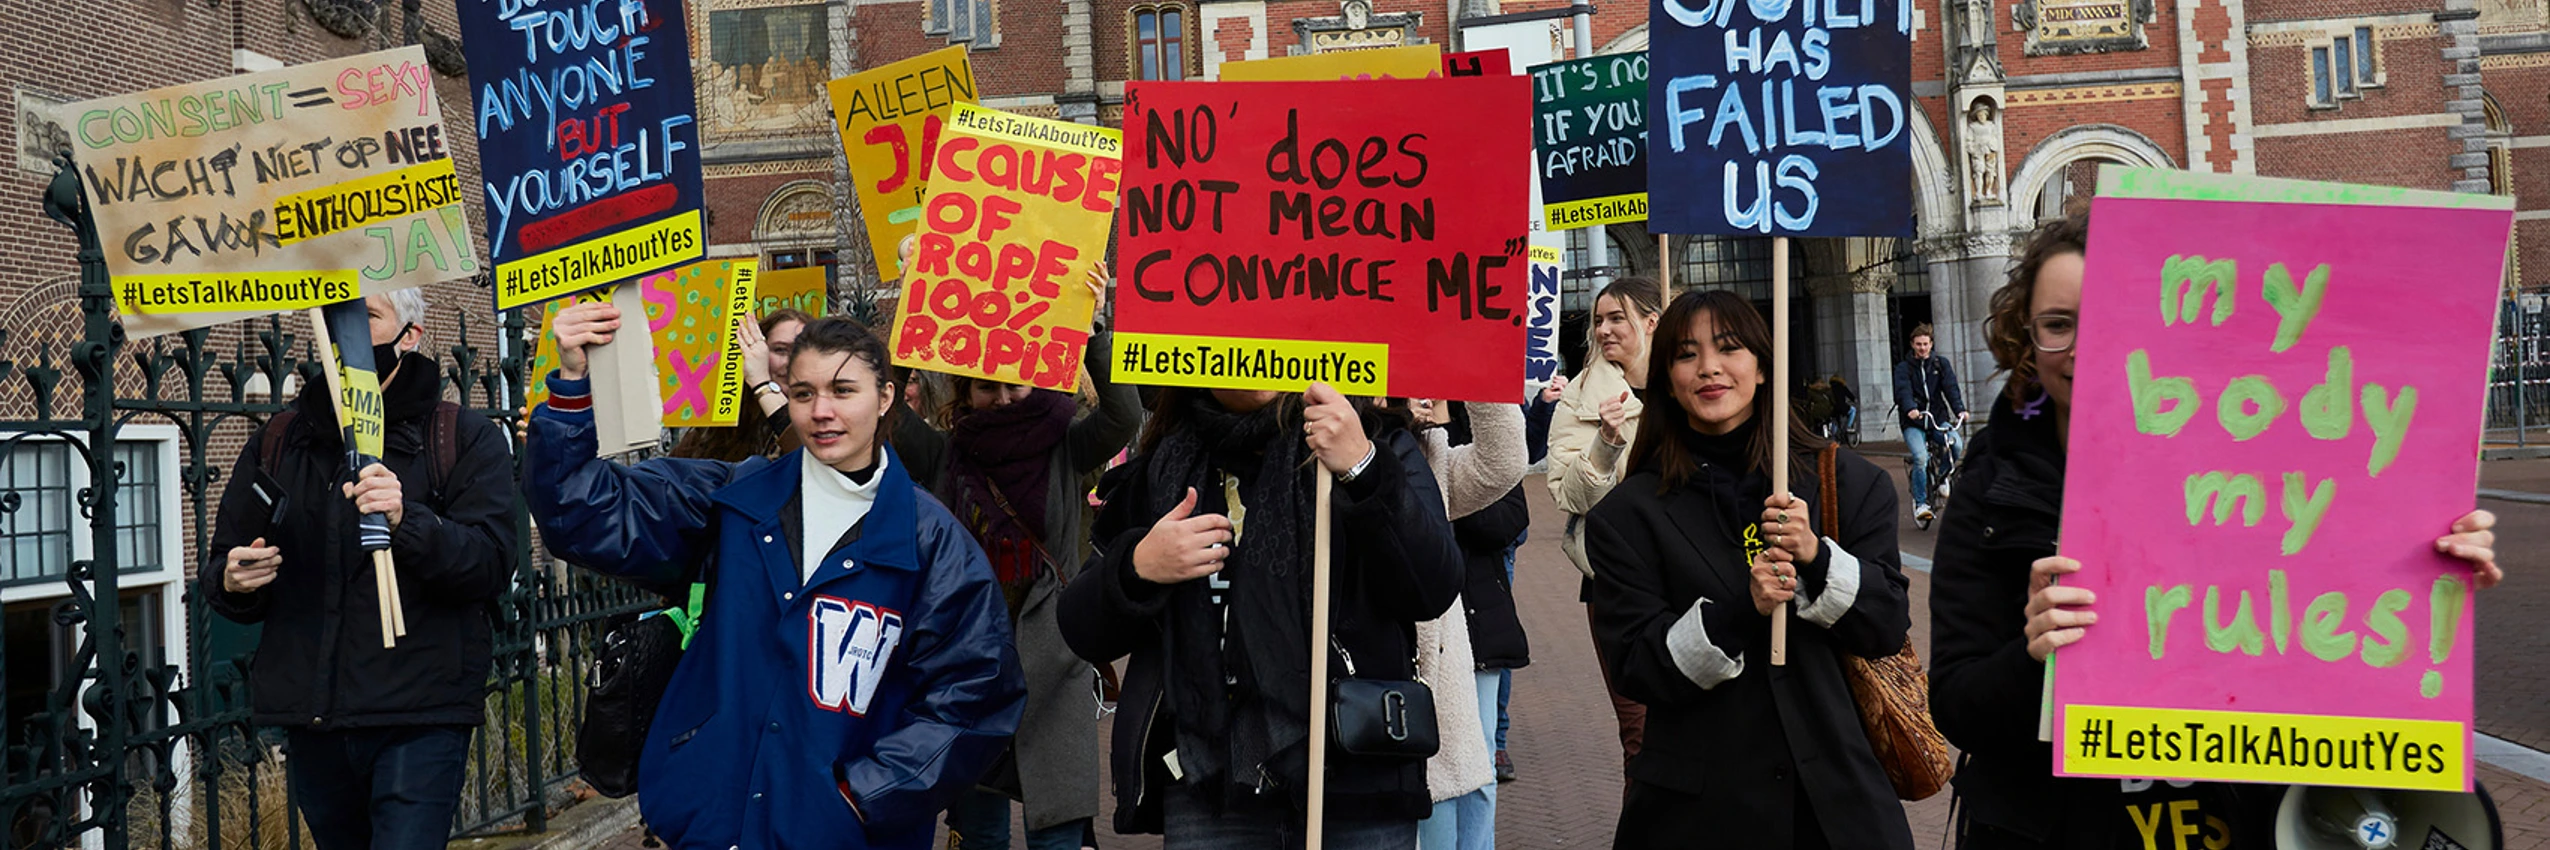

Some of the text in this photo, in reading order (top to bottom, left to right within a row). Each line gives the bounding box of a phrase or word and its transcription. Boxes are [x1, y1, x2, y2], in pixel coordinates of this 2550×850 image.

[510, 0, 650, 64] TOUCH
[1724, 27, 1831, 81] HAS
[77, 81, 291, 150] CONSENT
[336, 60, 431, 117] SEXY
[480, 36, 655, 152] ANYONE
[845, 59, 974, 131] ALLEEN
[1533, 62, 1599, 104] IT'S
[1665, 74, 1905, 155] FAILED
[557, 103, 632, 161] BUT
[957, 109, 1119, 153] #LetsTalkAboutYes
[1265, 107, 1429, 190] does
[1542, 98, 1643, 146] IF YOU
[85, 142, 243, 205] WACHT
[335, 137, 381, 171] OP
[384, 124, 448, 167] NEE
[486, 115, 693, 259] YOURSELF
[1545, 134, 1637, 180] AFRAID
[926, 192, 1023, 243] OF
[1126, 179, 1241, 238] NOT
[361, 205, 477, 282] JA!
[505, 227, 695, 298] #LetsTalkAboutYes
[123, 276, 351, 307] #LetsTalkAboutYes
[906, 278, 1051, 330] 100%
[2159, 253, 2333, 354] my
[1122, 342, 1378, 385] #LetsTalkAboutYes
[2125, 344, 2419, 479] body
[2182, 470, 2337, 556] my
[2143, 568, 2468, 700] rules!
[2079, 717, 2447, 776] #LetsTalkAboutYes
